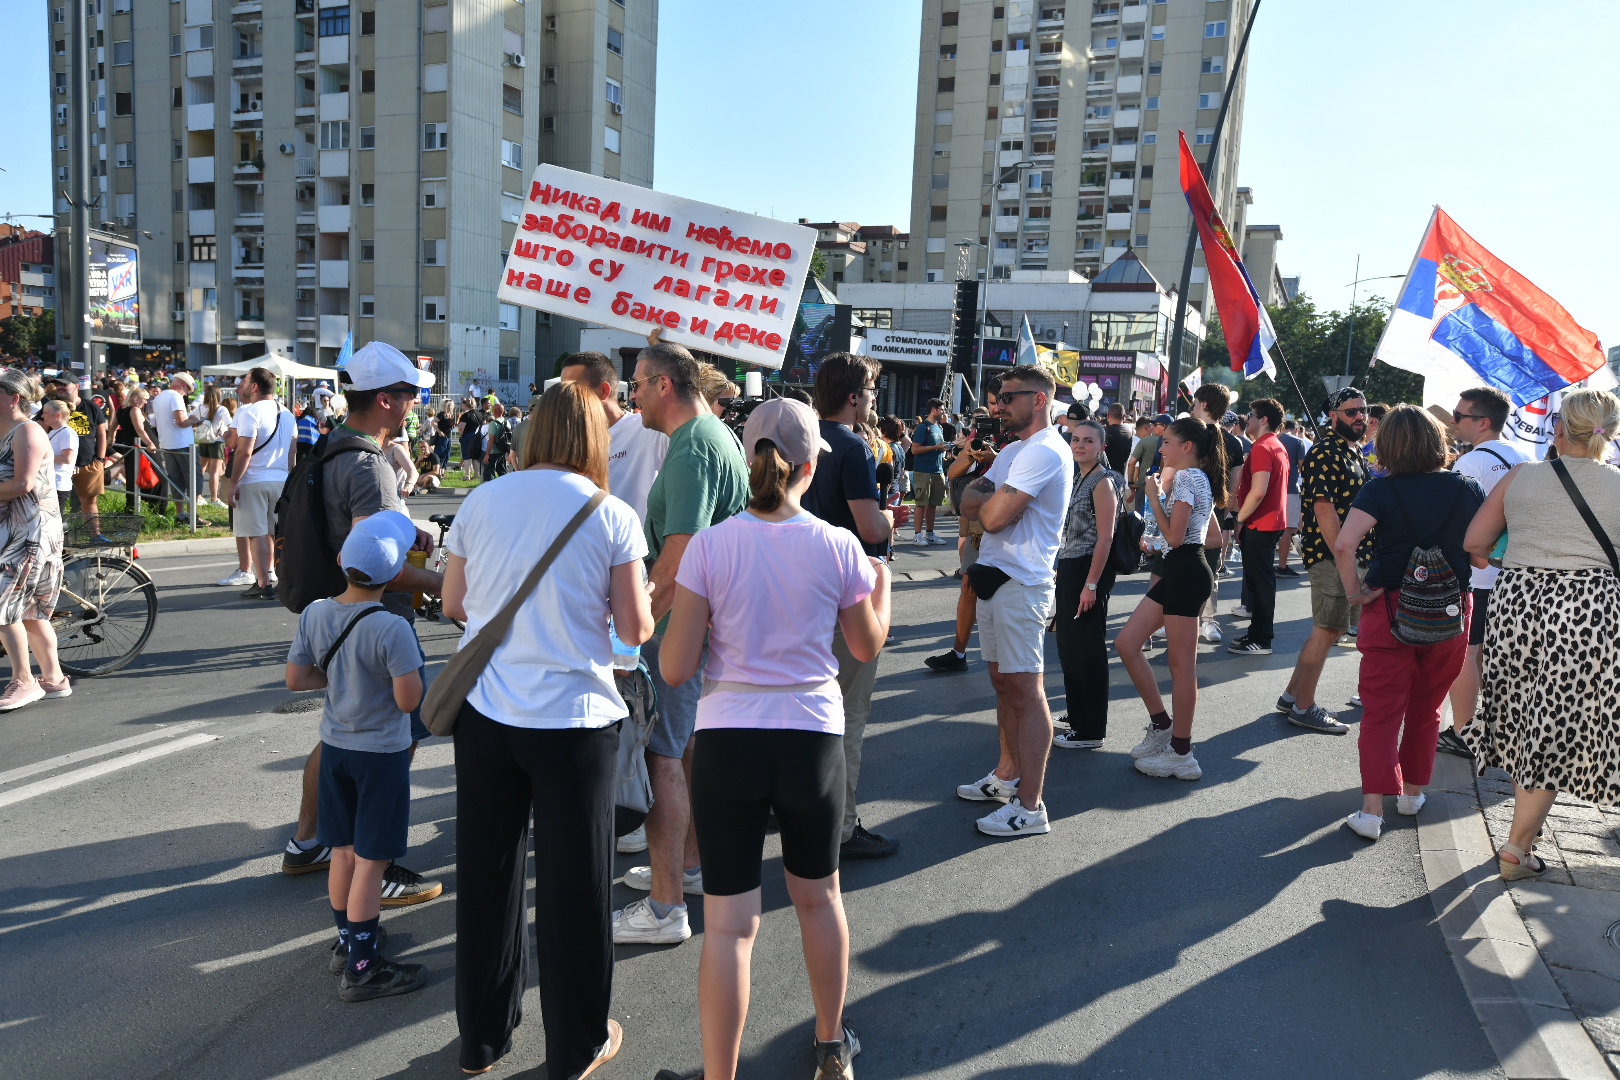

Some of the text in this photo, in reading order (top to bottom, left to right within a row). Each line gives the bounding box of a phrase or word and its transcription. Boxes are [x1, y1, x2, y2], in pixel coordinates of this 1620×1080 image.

[522, 213, 786, 287] заборавити грехе
[632, 208, 671, 233] им
[686, 222, 792, 260] нећемо
[112, 271, 132, 291] VAR
[513, 239, 779, 314] што су лагали
[505, 268, 783, 351] наше баке и деке
[872, 345, 932, 356] ПОЛИКЛИНИКА
